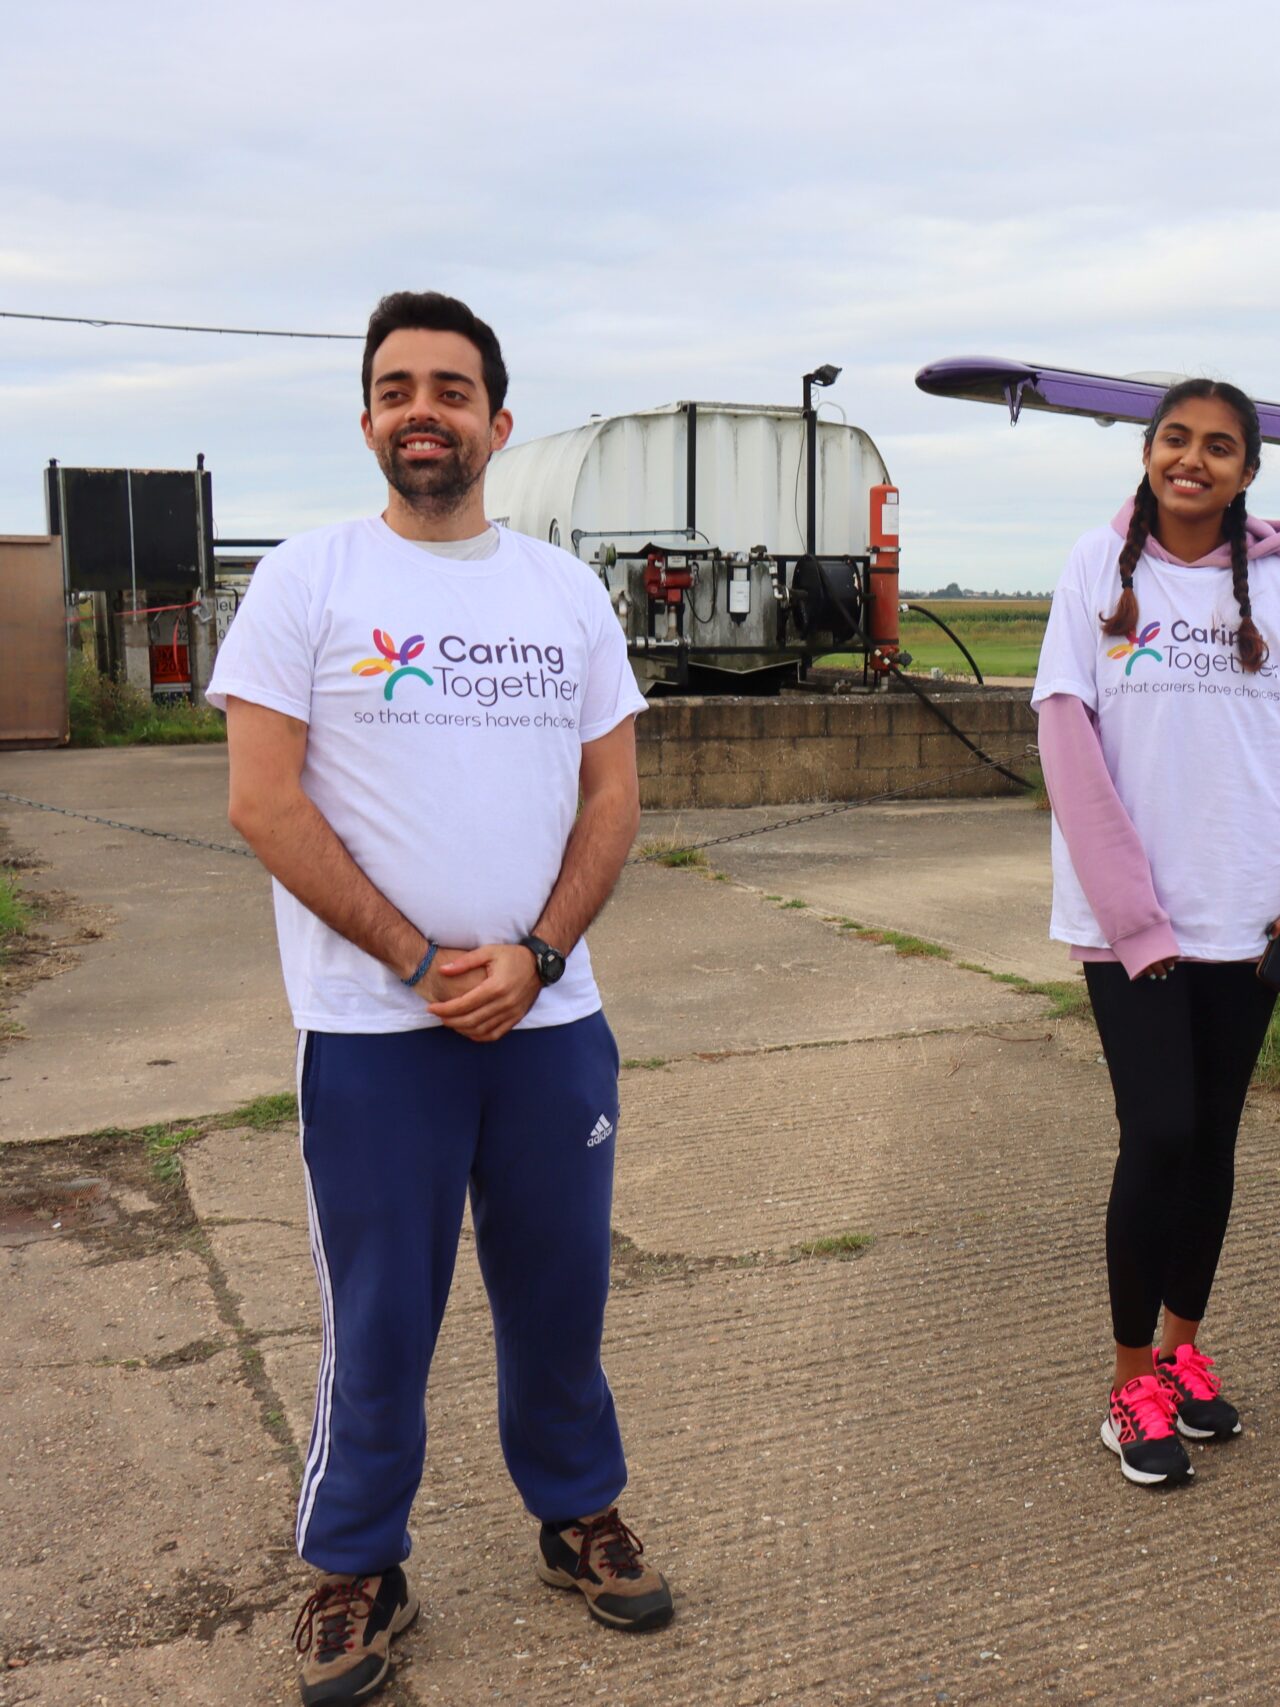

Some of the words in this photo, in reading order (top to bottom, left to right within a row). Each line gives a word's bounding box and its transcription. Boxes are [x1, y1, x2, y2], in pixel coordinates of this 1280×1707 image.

[1171, 620, 1240, 647] Carin
[438, 635, 564, 674] Caring
[1163, 645, 1278, 678] Togeter
[432, 666, 579, 707] Together
[1104, 687, 1118, 697] so
[1120, 681, 1150, 694] that
[1152, 681, 1195, 694] carers
[1198, 680, 1232, 695] have
[1234, 685, 1280, 701] choices
[353, 711, 375, 724] so
[378, 708, 421, 725] that
[424, 711, 482, 727] carers
[485, 712, 531, 728] have
